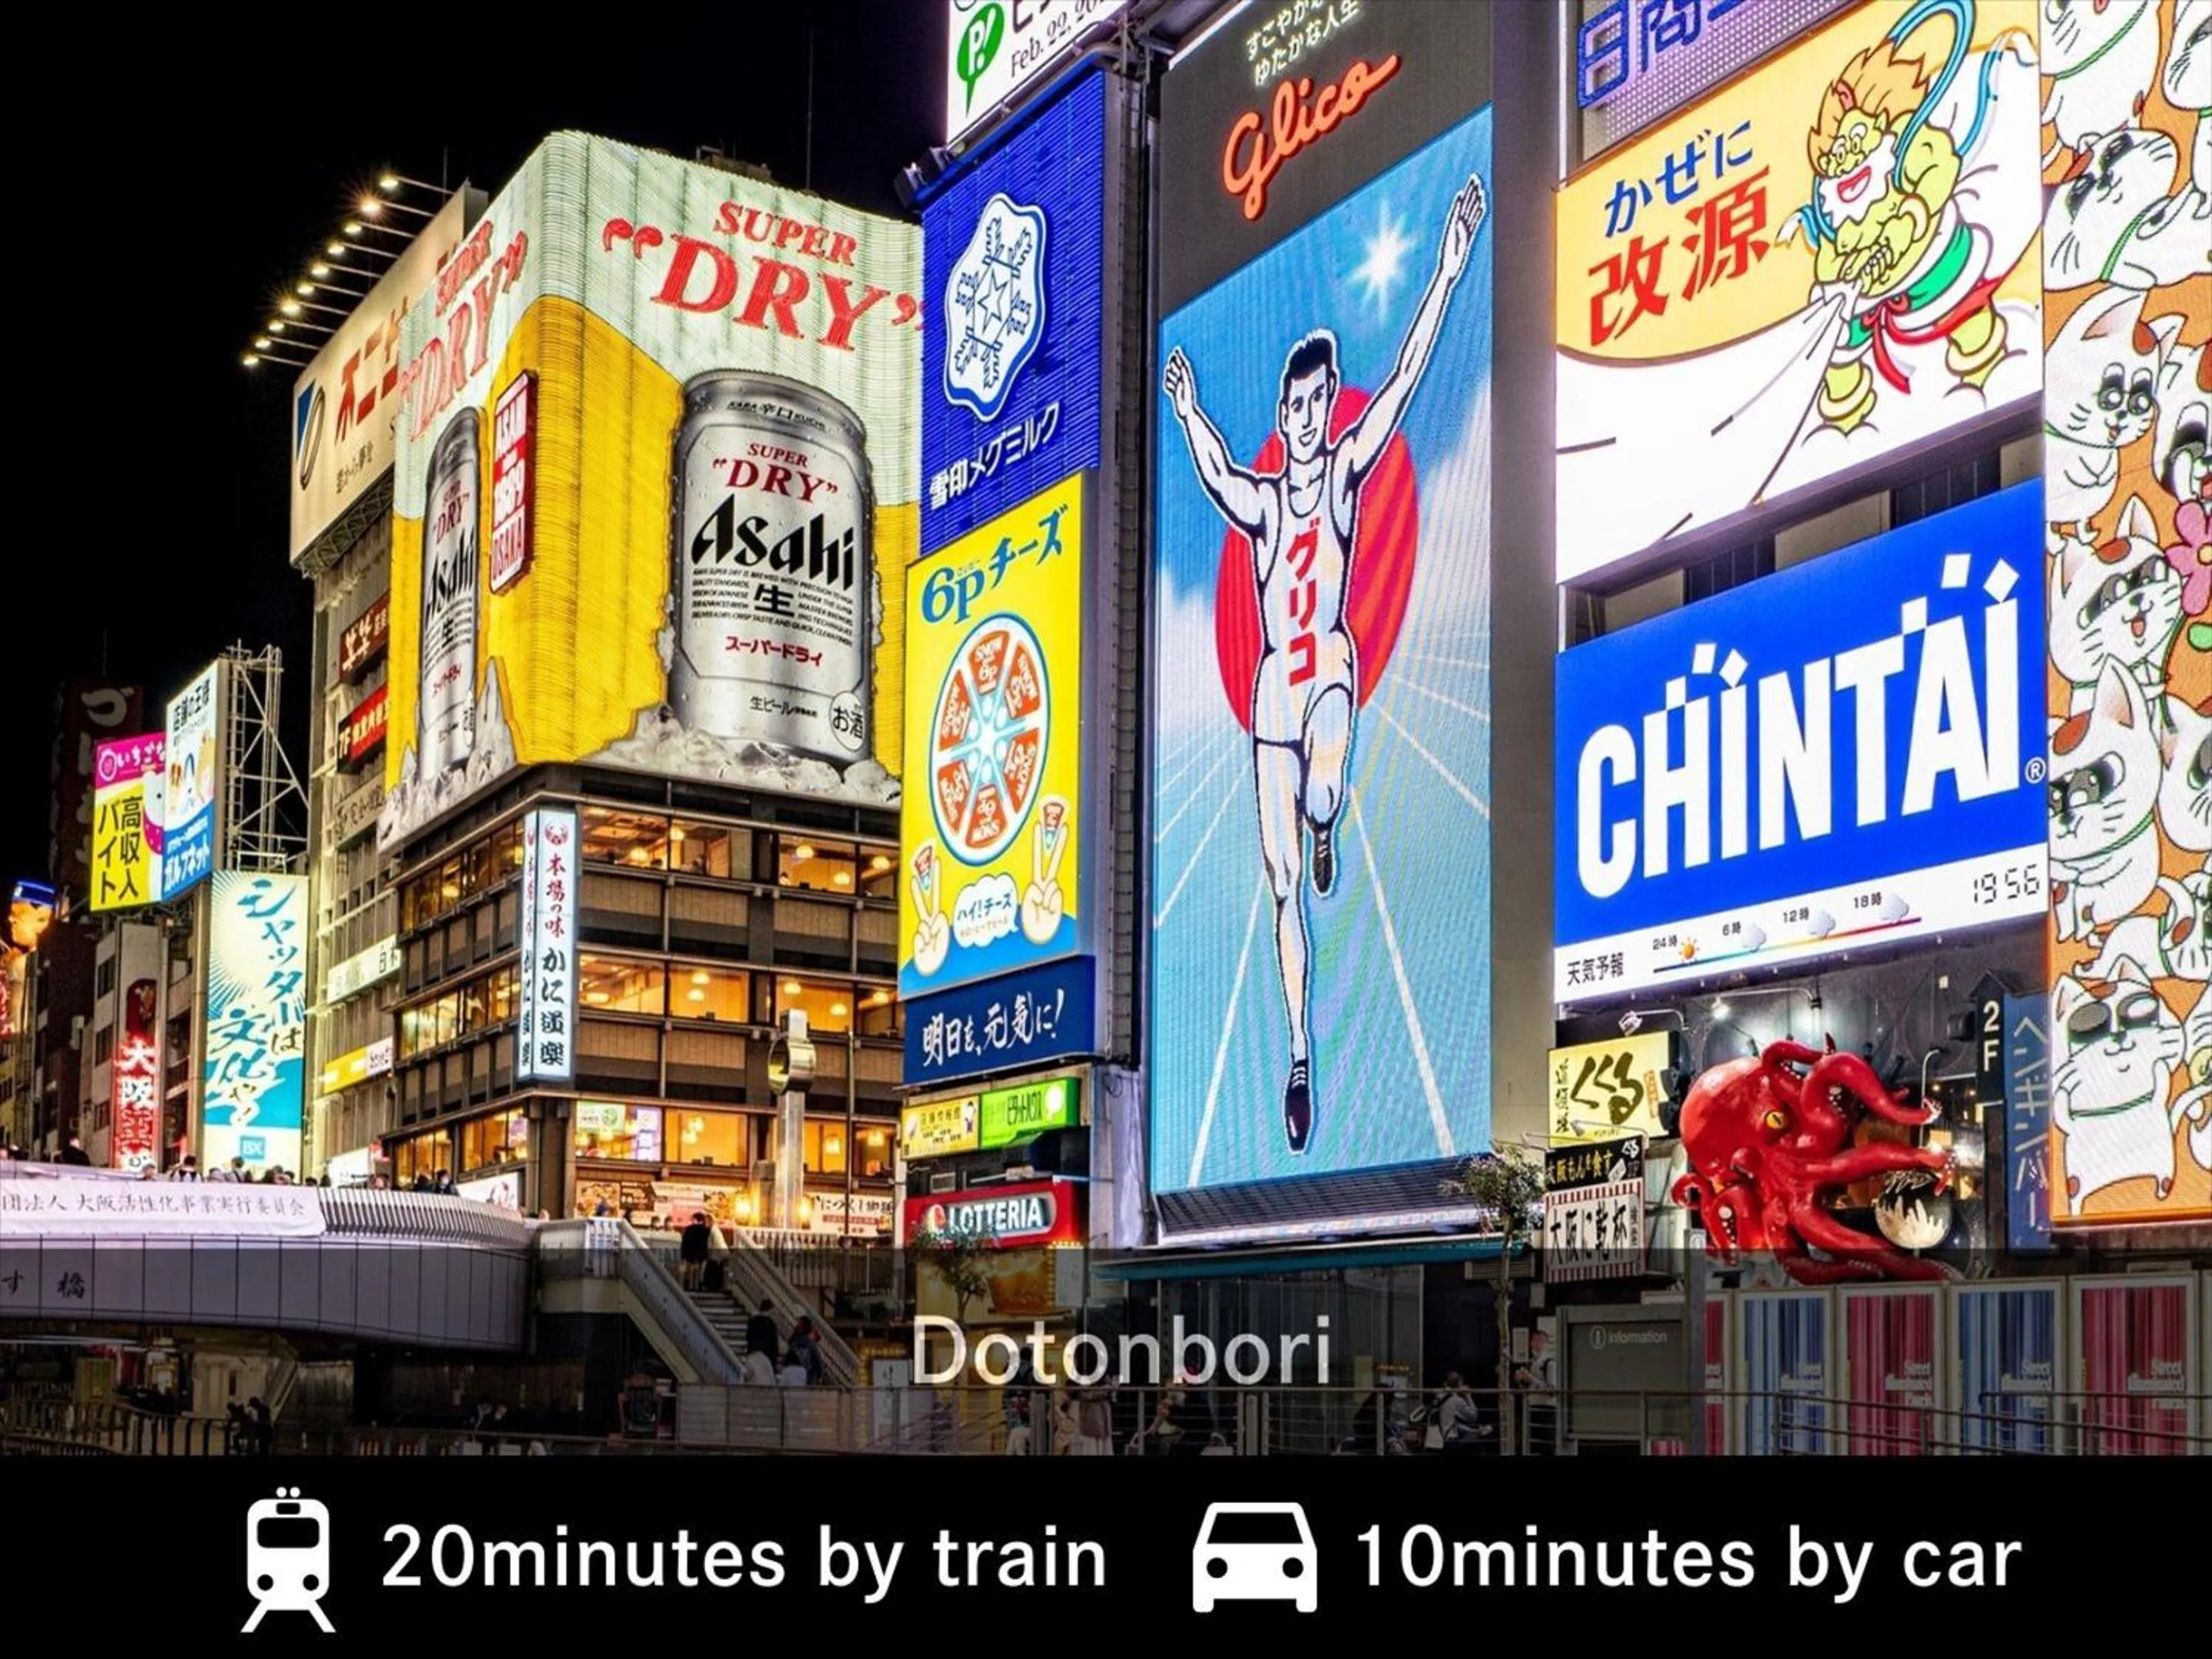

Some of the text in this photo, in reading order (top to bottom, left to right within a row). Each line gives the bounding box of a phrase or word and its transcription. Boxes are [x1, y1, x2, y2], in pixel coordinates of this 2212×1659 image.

[1011, 38, 1044, 78] Feb.
[1223, 55, 1400, 220] Glico
[1604, 121, 1753, 238] かぜに
[715, 200, 859, 267] SUPER
[1588, 164, 1770, 347] 改源
[747, 442, 808, 468] SUPER
[929, 402, 1059, 511] 雪印メグミルク
[691, 493, 855, 591] Asahi
[754, 584, 796, 619] 生
[1286, 517, 1320, 687] グリコ
[725, 636, 823, 667] スーパードライ
[98, 800, 121, 906] バイト
[118, 796, 144, 900] 高収入
[545, 853, 566, 938] 本場の味
[539, 947, 567, 1066] かに道楽
[1567, 953, 1624, 987] 天気予報
[1983, 1001, 1999, 1072] 2F
[1570, 1051, 1644, 1125] くくる
[949, 1197, 1043, 1234] LOTTERIA
